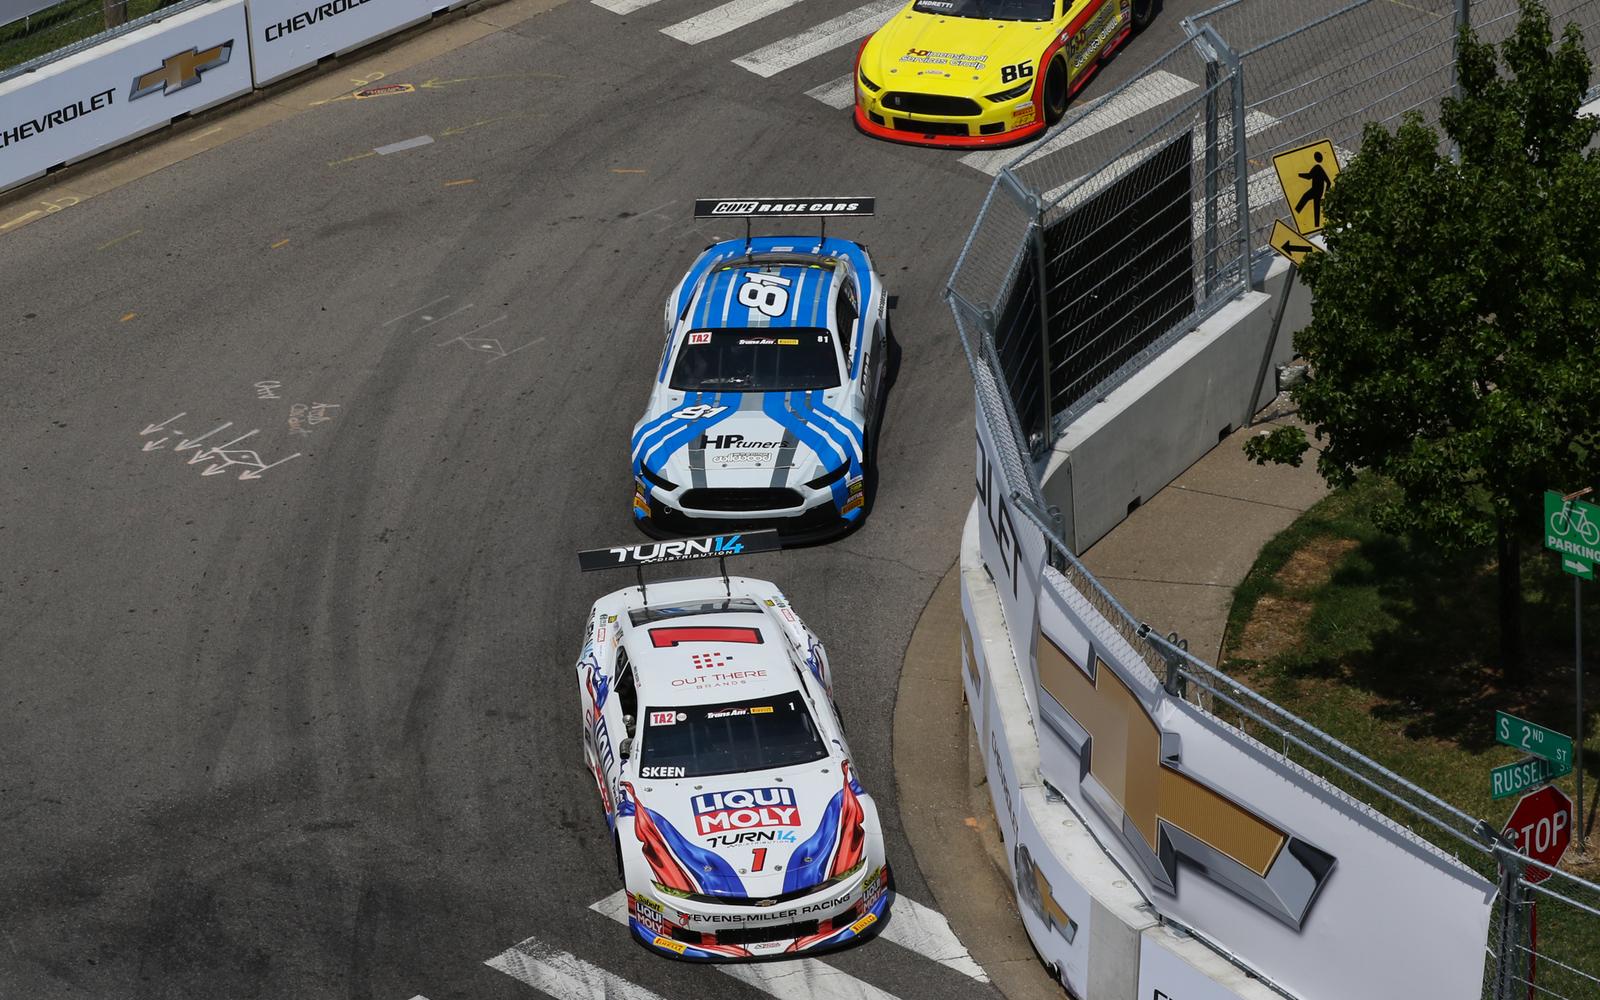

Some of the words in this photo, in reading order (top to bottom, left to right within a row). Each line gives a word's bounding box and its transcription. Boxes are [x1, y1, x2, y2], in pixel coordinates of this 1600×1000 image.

[917, 0, 953, 9] ANDRETTI
[264, 0, 371, 42] CHEVROL
[950, 58, 986, 70] Group
[1001, 60, 1034, 84] 86
[758, 203, 807, 212] RACE
[809, 203, 860, 212] CARS
[691, 333, 710, 343] TA2
[671, 404, 729, 420] 81
[699, 434, 790, 449] HPtuners
[610, 535, 745, 562] TURN14
[656, 550, 734, 561] DISTRIBUTION
[1548, 535, 1600, 563] PARKING
[671, 674, 708, 688] OUT
[711, 669, 768, 681] THERE
[696, 680, 747, 690] BRANDS
[707, 711, 730, 719] Trans
[788, 702, 796, 711] 1
[652, 712, 674, 724] TA2
[1500, 718, 1510, 740] S
[1556, 748, 1567, 762] ST
[641, 767, 685, 778] SKEEN
[1493, 758, 1553, 796] RUSSELL
[694, 789, 793, 813] LIQUI
[698, 808, 799, 835] MOLY
[706, 830, 797, 848] TURN14
[751, 847, 768, 873] 1
[863, 876, 881, 901] LIQUI
[802, 894, 852, 914] RACING
[863, 888, 882, 914] MOLY
[636, 902, 664, 923] LIQUI
[636, 914, 664, 933] MOLY
